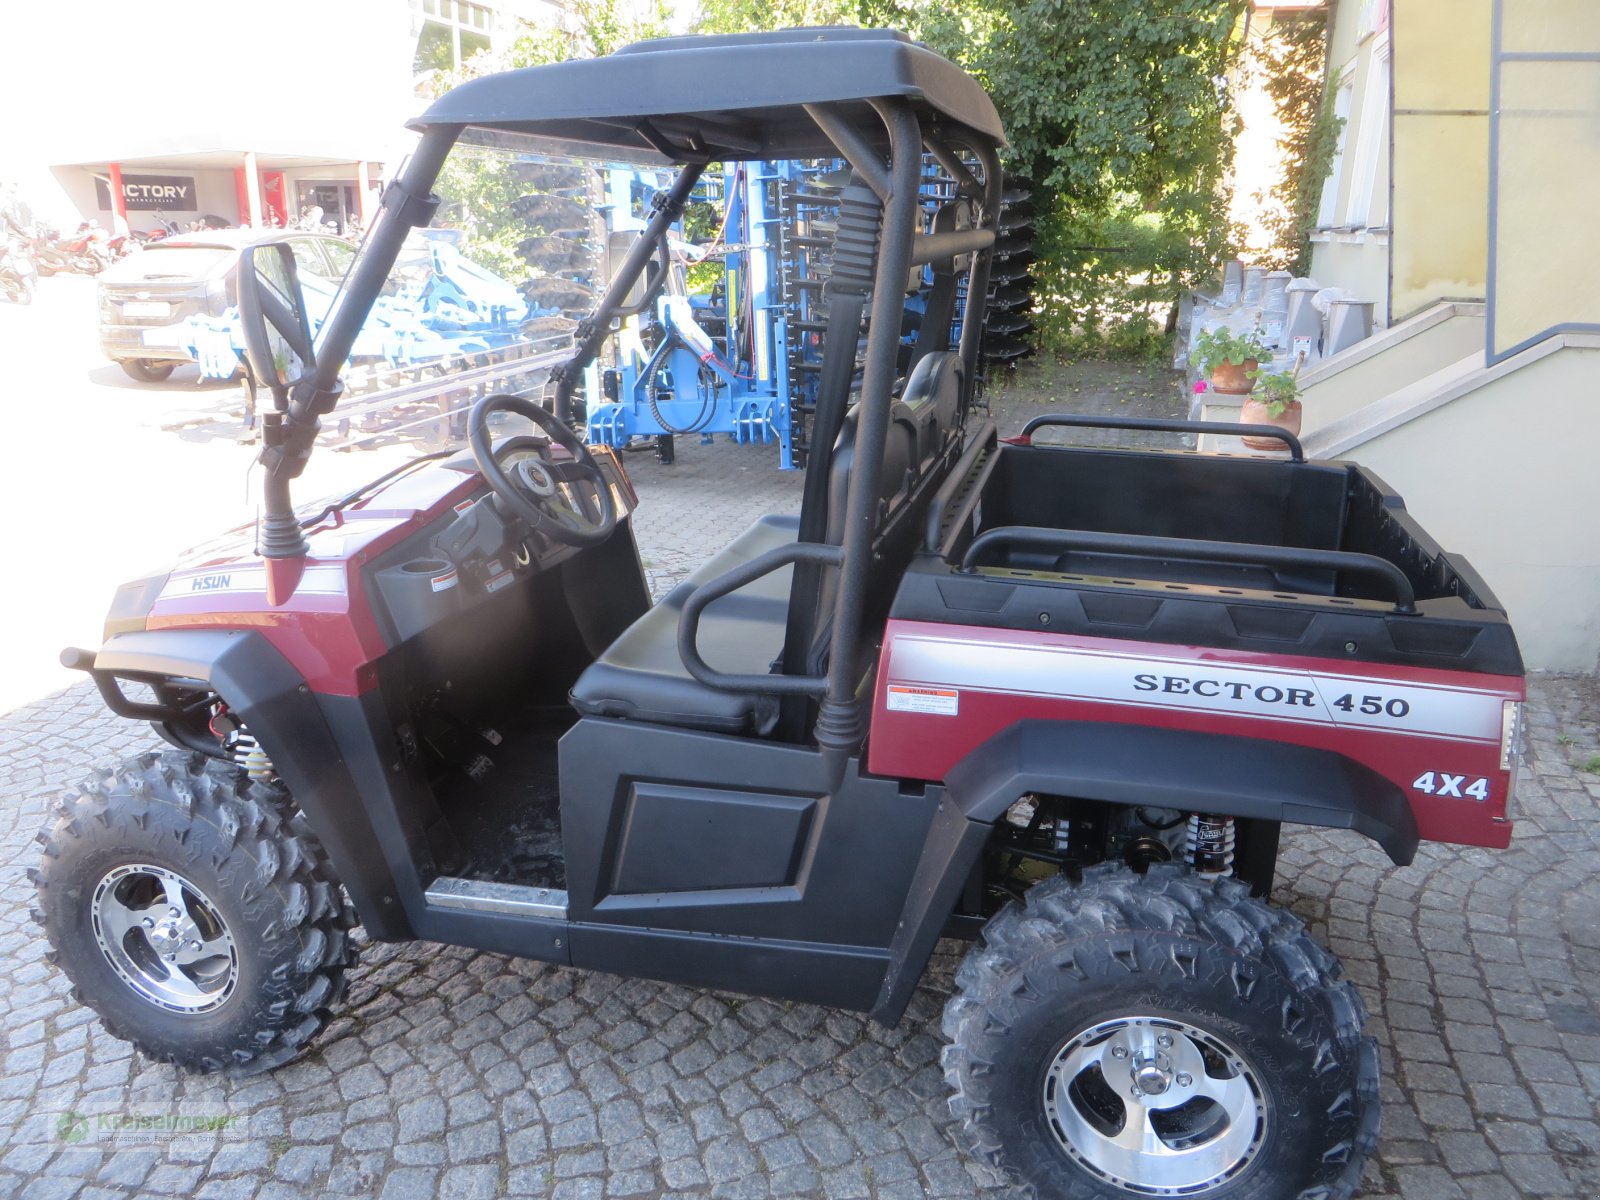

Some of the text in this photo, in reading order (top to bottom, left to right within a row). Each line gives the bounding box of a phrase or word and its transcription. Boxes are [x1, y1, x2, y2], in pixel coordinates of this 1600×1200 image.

[106, 183, 187, 198] ICTORY
[191, 574, 231, 591] HSUN
[1133, 674, 1410, 718] SECTOR 450
[1412, 771, 1488, 801] 4X4
